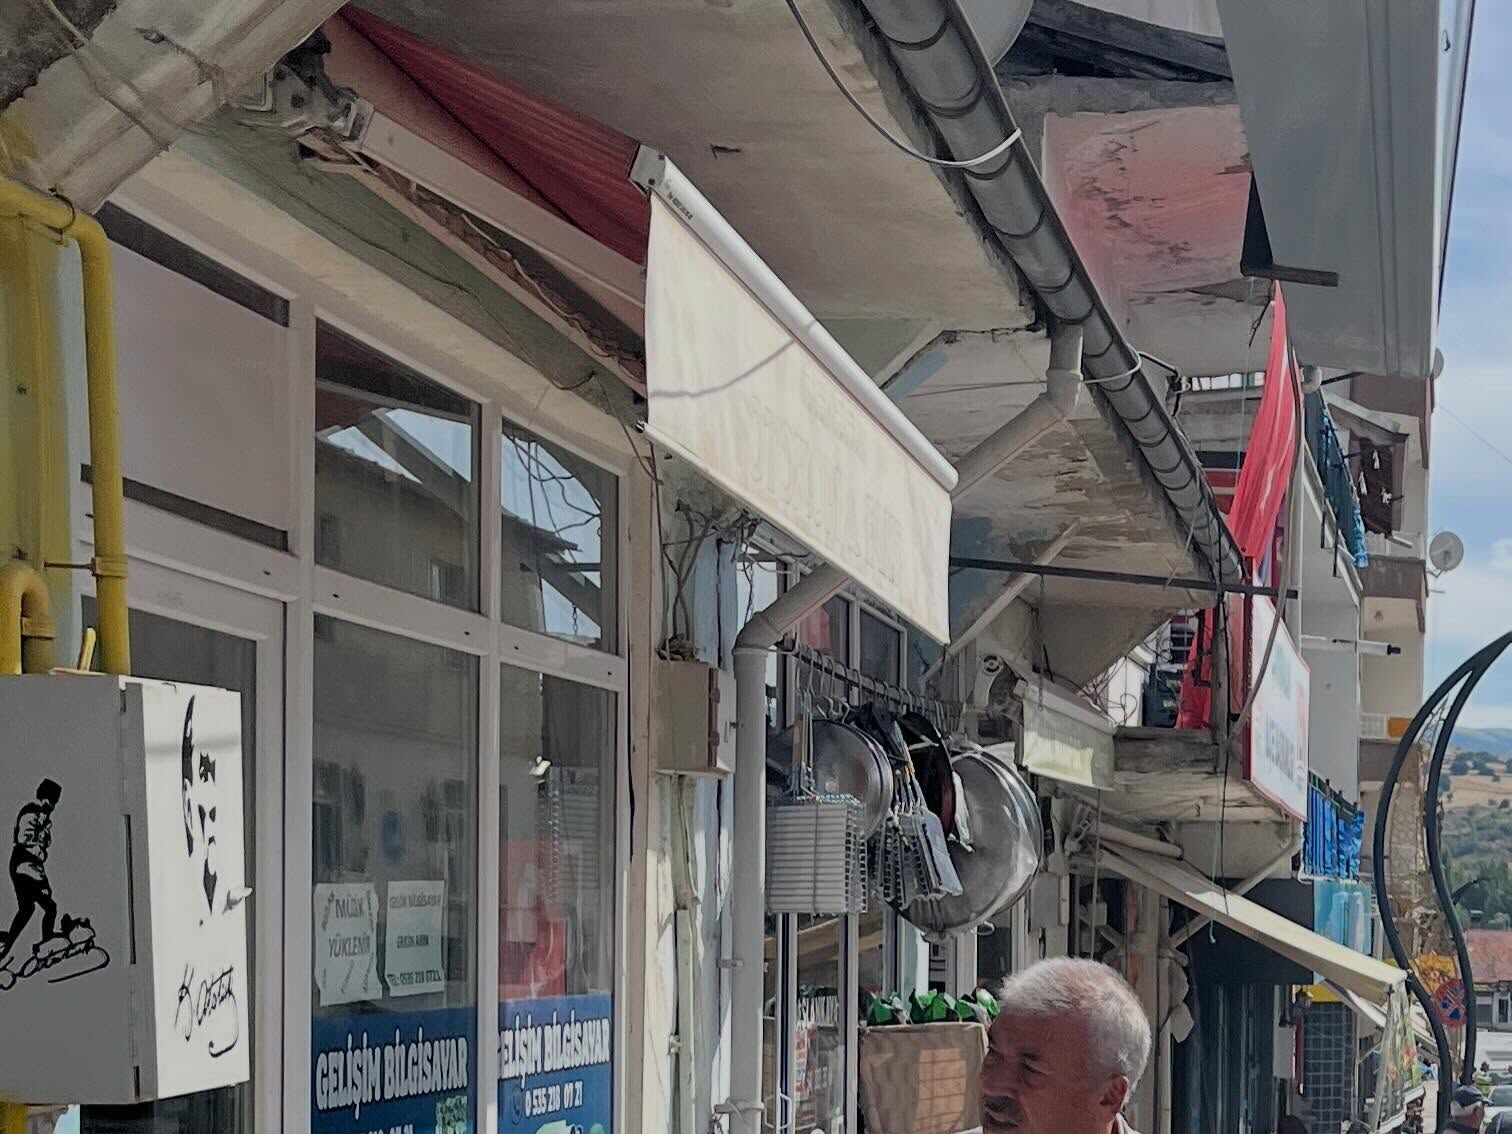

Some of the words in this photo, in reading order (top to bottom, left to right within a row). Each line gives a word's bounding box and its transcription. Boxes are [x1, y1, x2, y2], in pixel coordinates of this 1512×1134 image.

[316, 1032, 381, 1120] GELİŞİM
[384, 1026, 468, 1099] BİLGİSAYAR
[499, 1014, 542, 1089] ELİŞİM
[543, 1009, 610, 1072] BİLGİSAYAR
